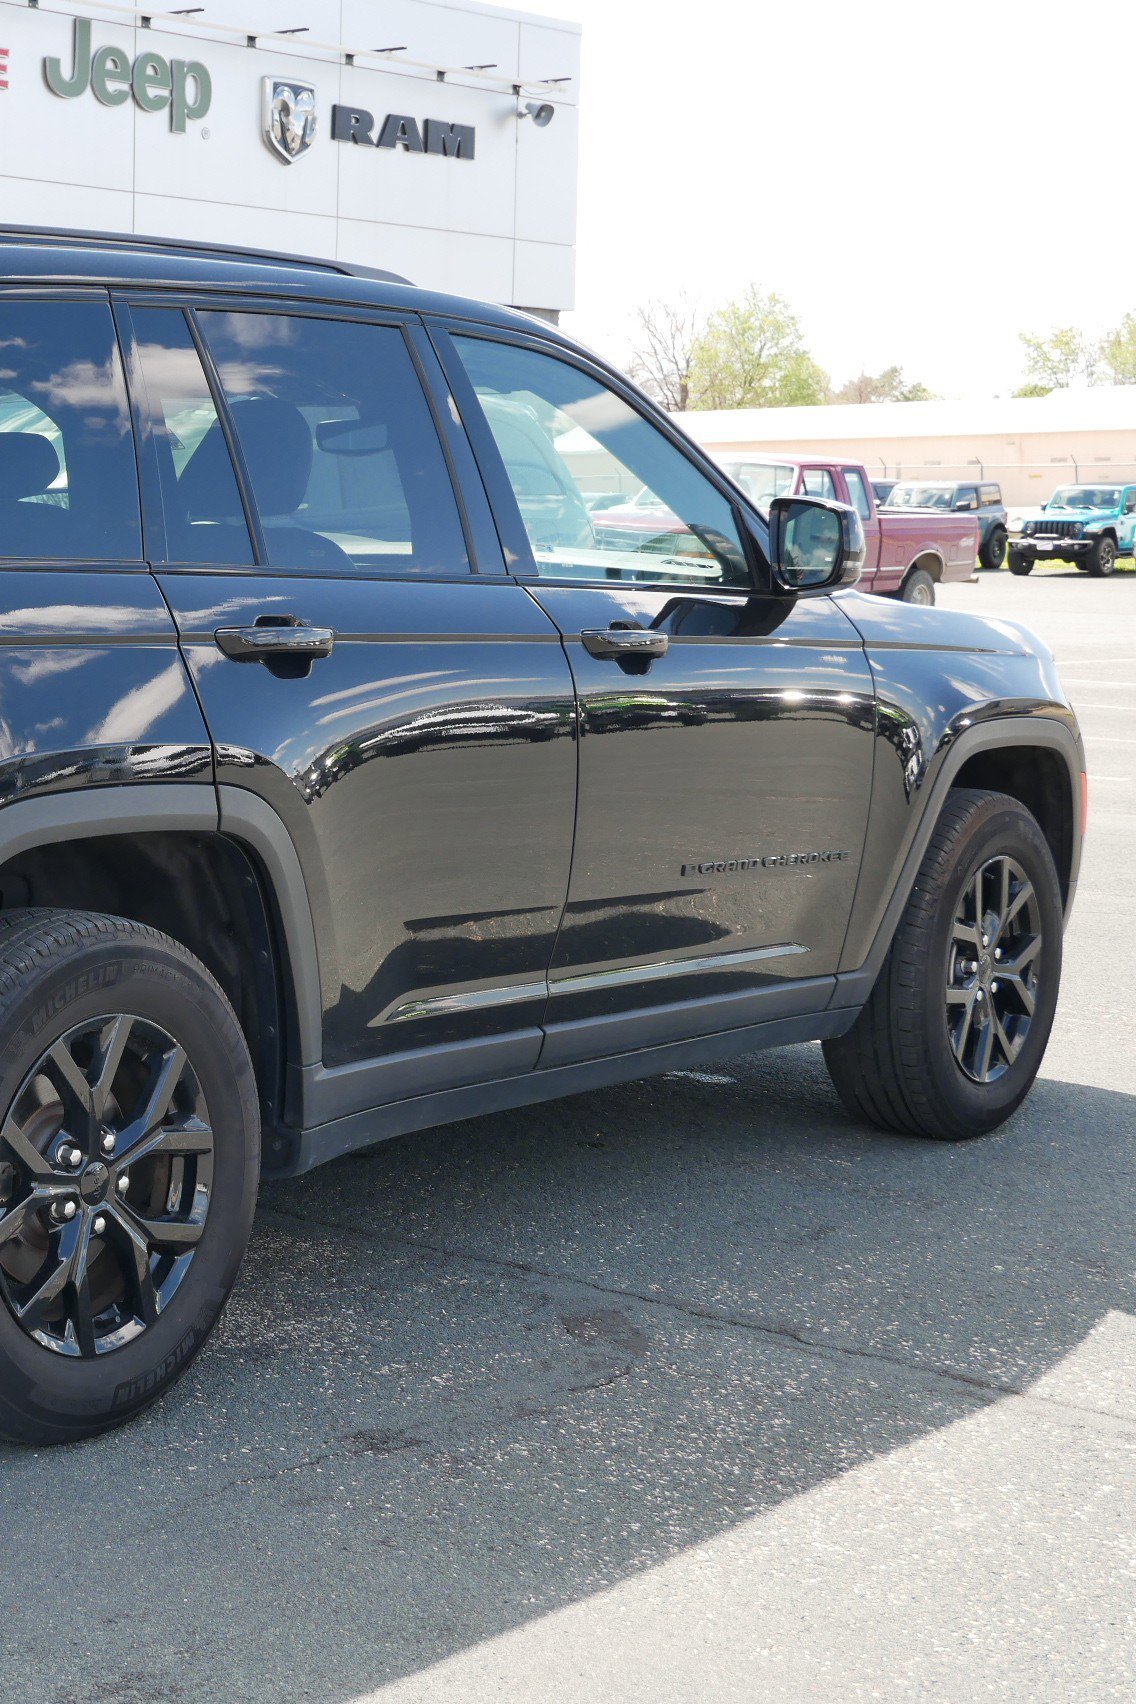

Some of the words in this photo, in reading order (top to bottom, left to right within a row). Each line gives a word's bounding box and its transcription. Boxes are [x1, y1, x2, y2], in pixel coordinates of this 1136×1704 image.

[43, 17, 212, 134] Jeep
[331, 104, 475, 160] RAM
[698, 858, 760, 875] GRAND
[761, 850, 852, 868] CHEROKEE
[31, 964, 120, 1031] MICHELIN
[115, 1329, 196, 1404] MICHELIN
